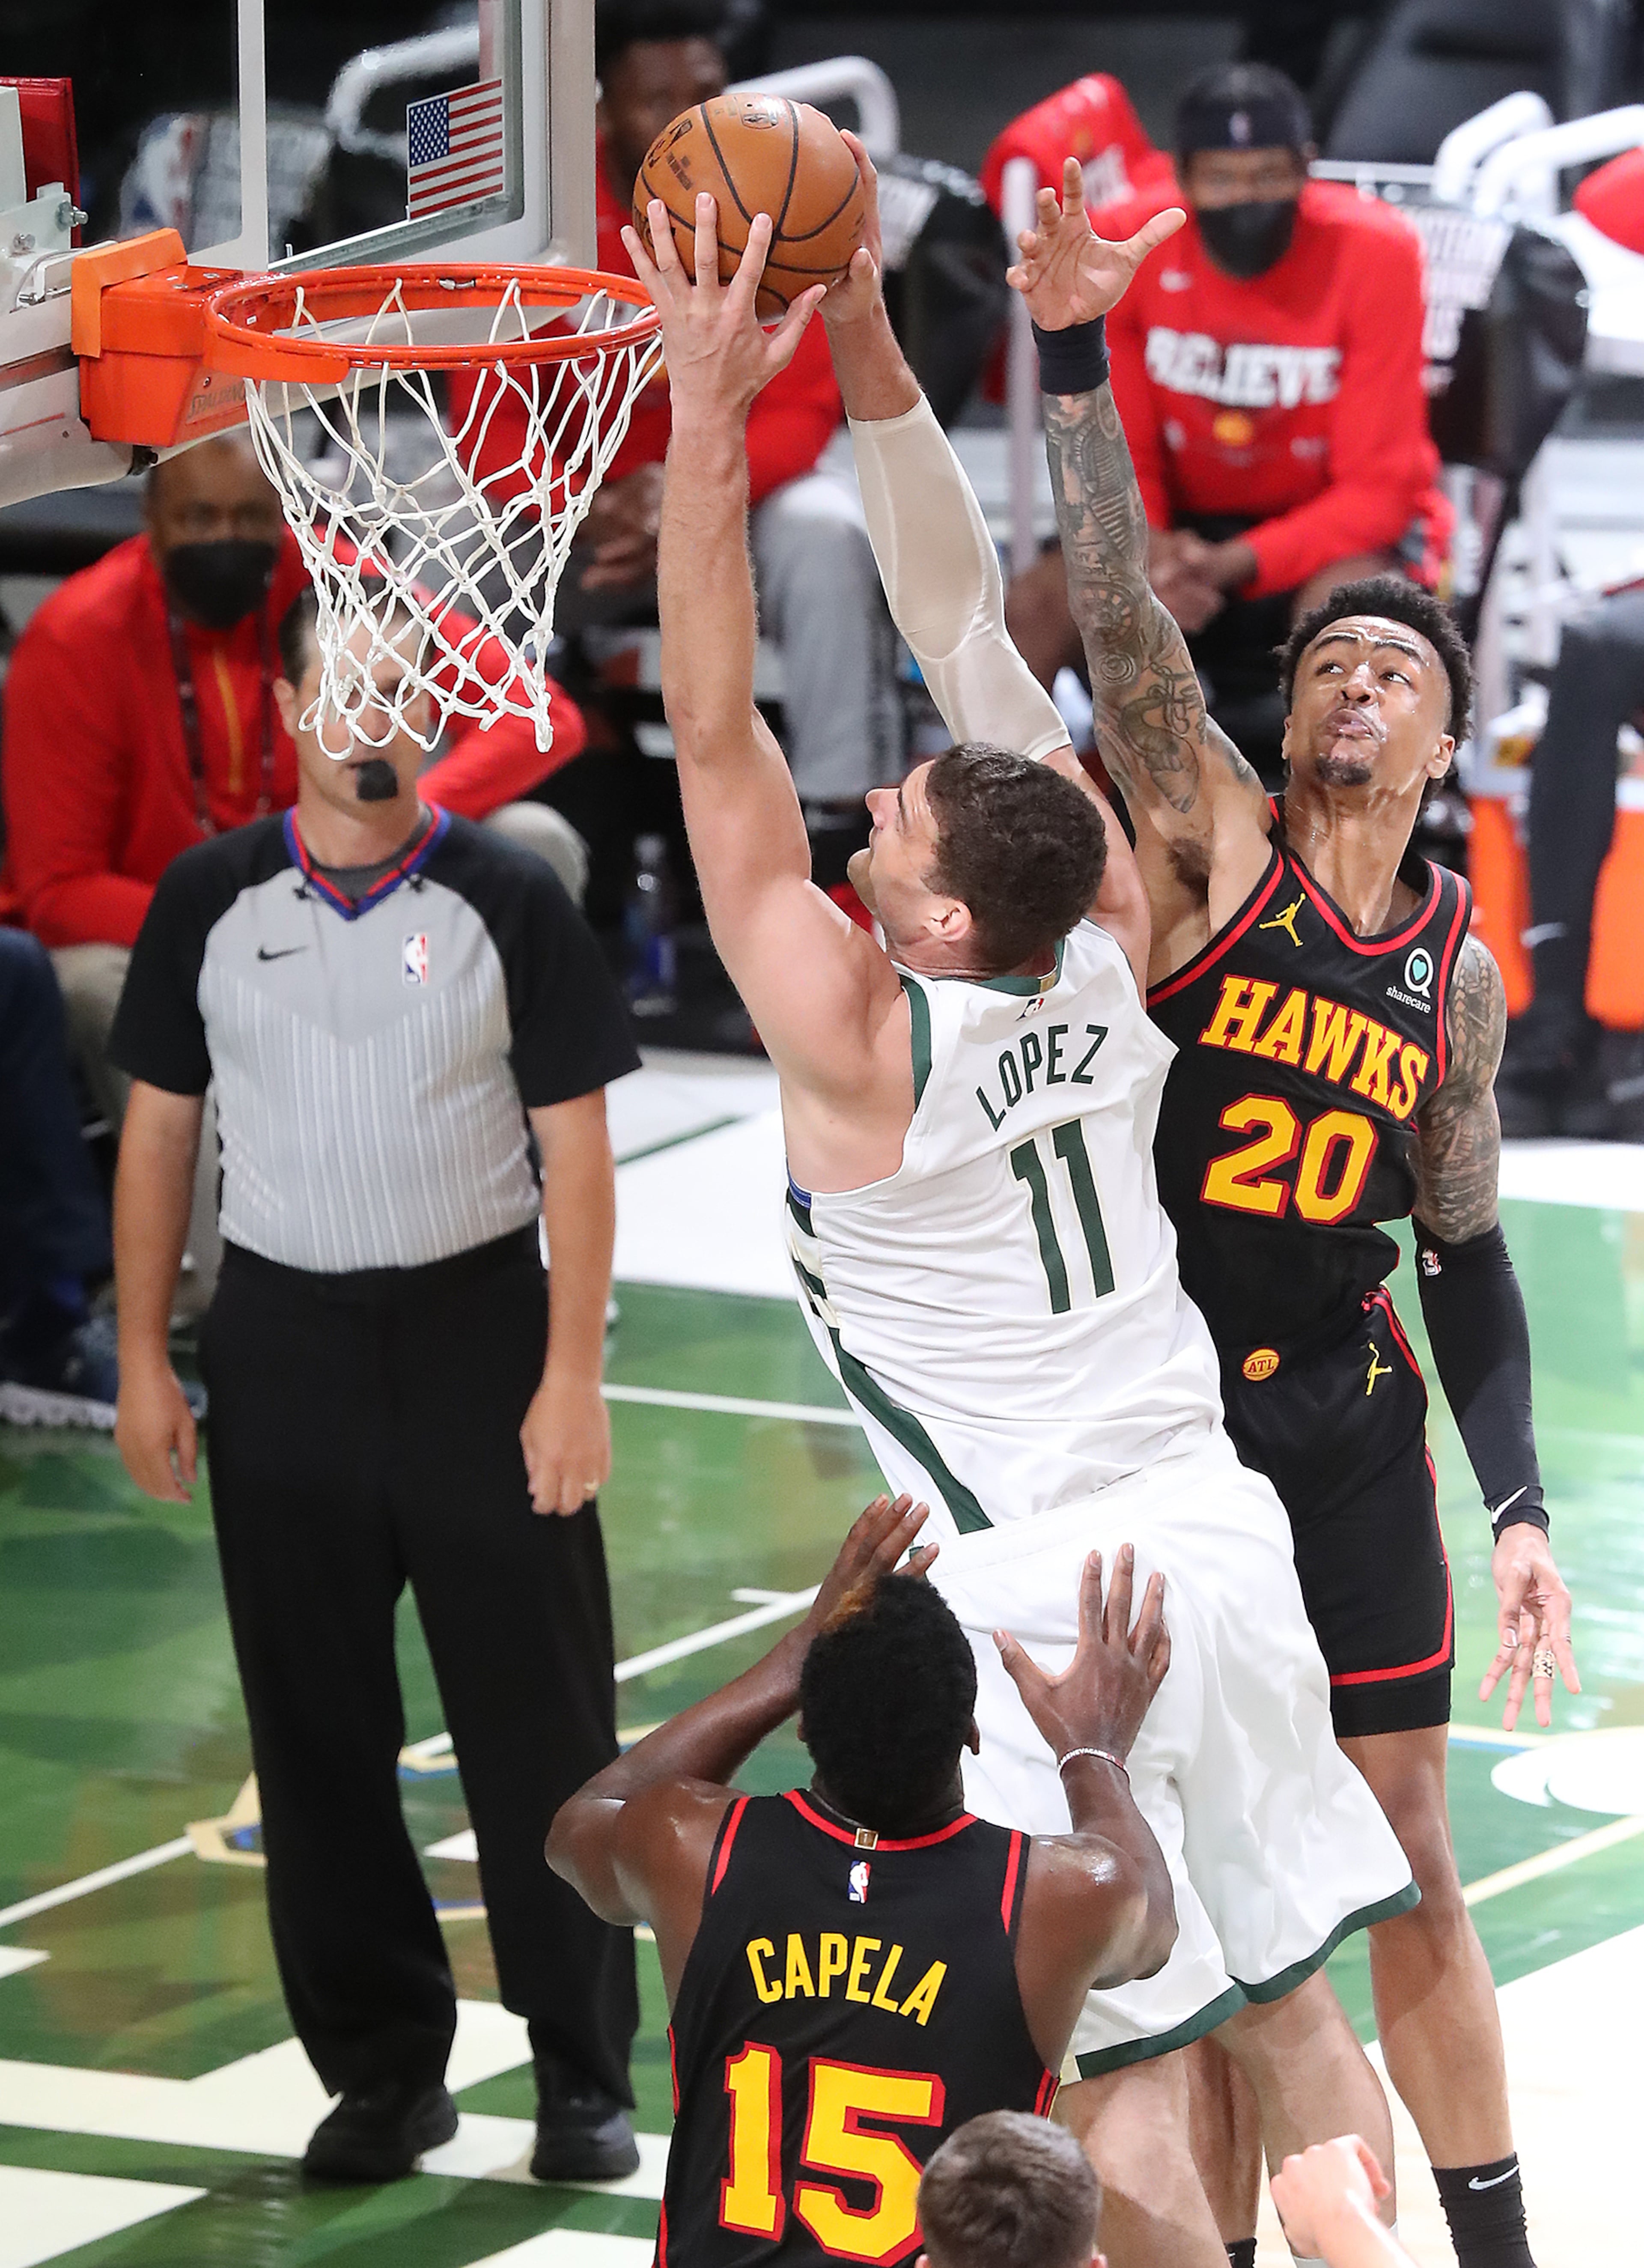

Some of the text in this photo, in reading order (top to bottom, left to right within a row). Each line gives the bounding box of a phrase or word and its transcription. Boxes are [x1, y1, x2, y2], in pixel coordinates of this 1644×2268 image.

[1197, 973, 1430, 1123] HAWKS
[1385, 985, 1431, 1013] sharecare
[975, 1023, 1109, 1132] LOPEZ
[1007, 1117, 1116, 1315] 11
[1200, 1093, 1379, 1225] 20
[1247, 1359, 1275, 1373] ATL
[745, 1932, 948, 2027] CAPELA
[718, 2040, 946, 2268] 15
